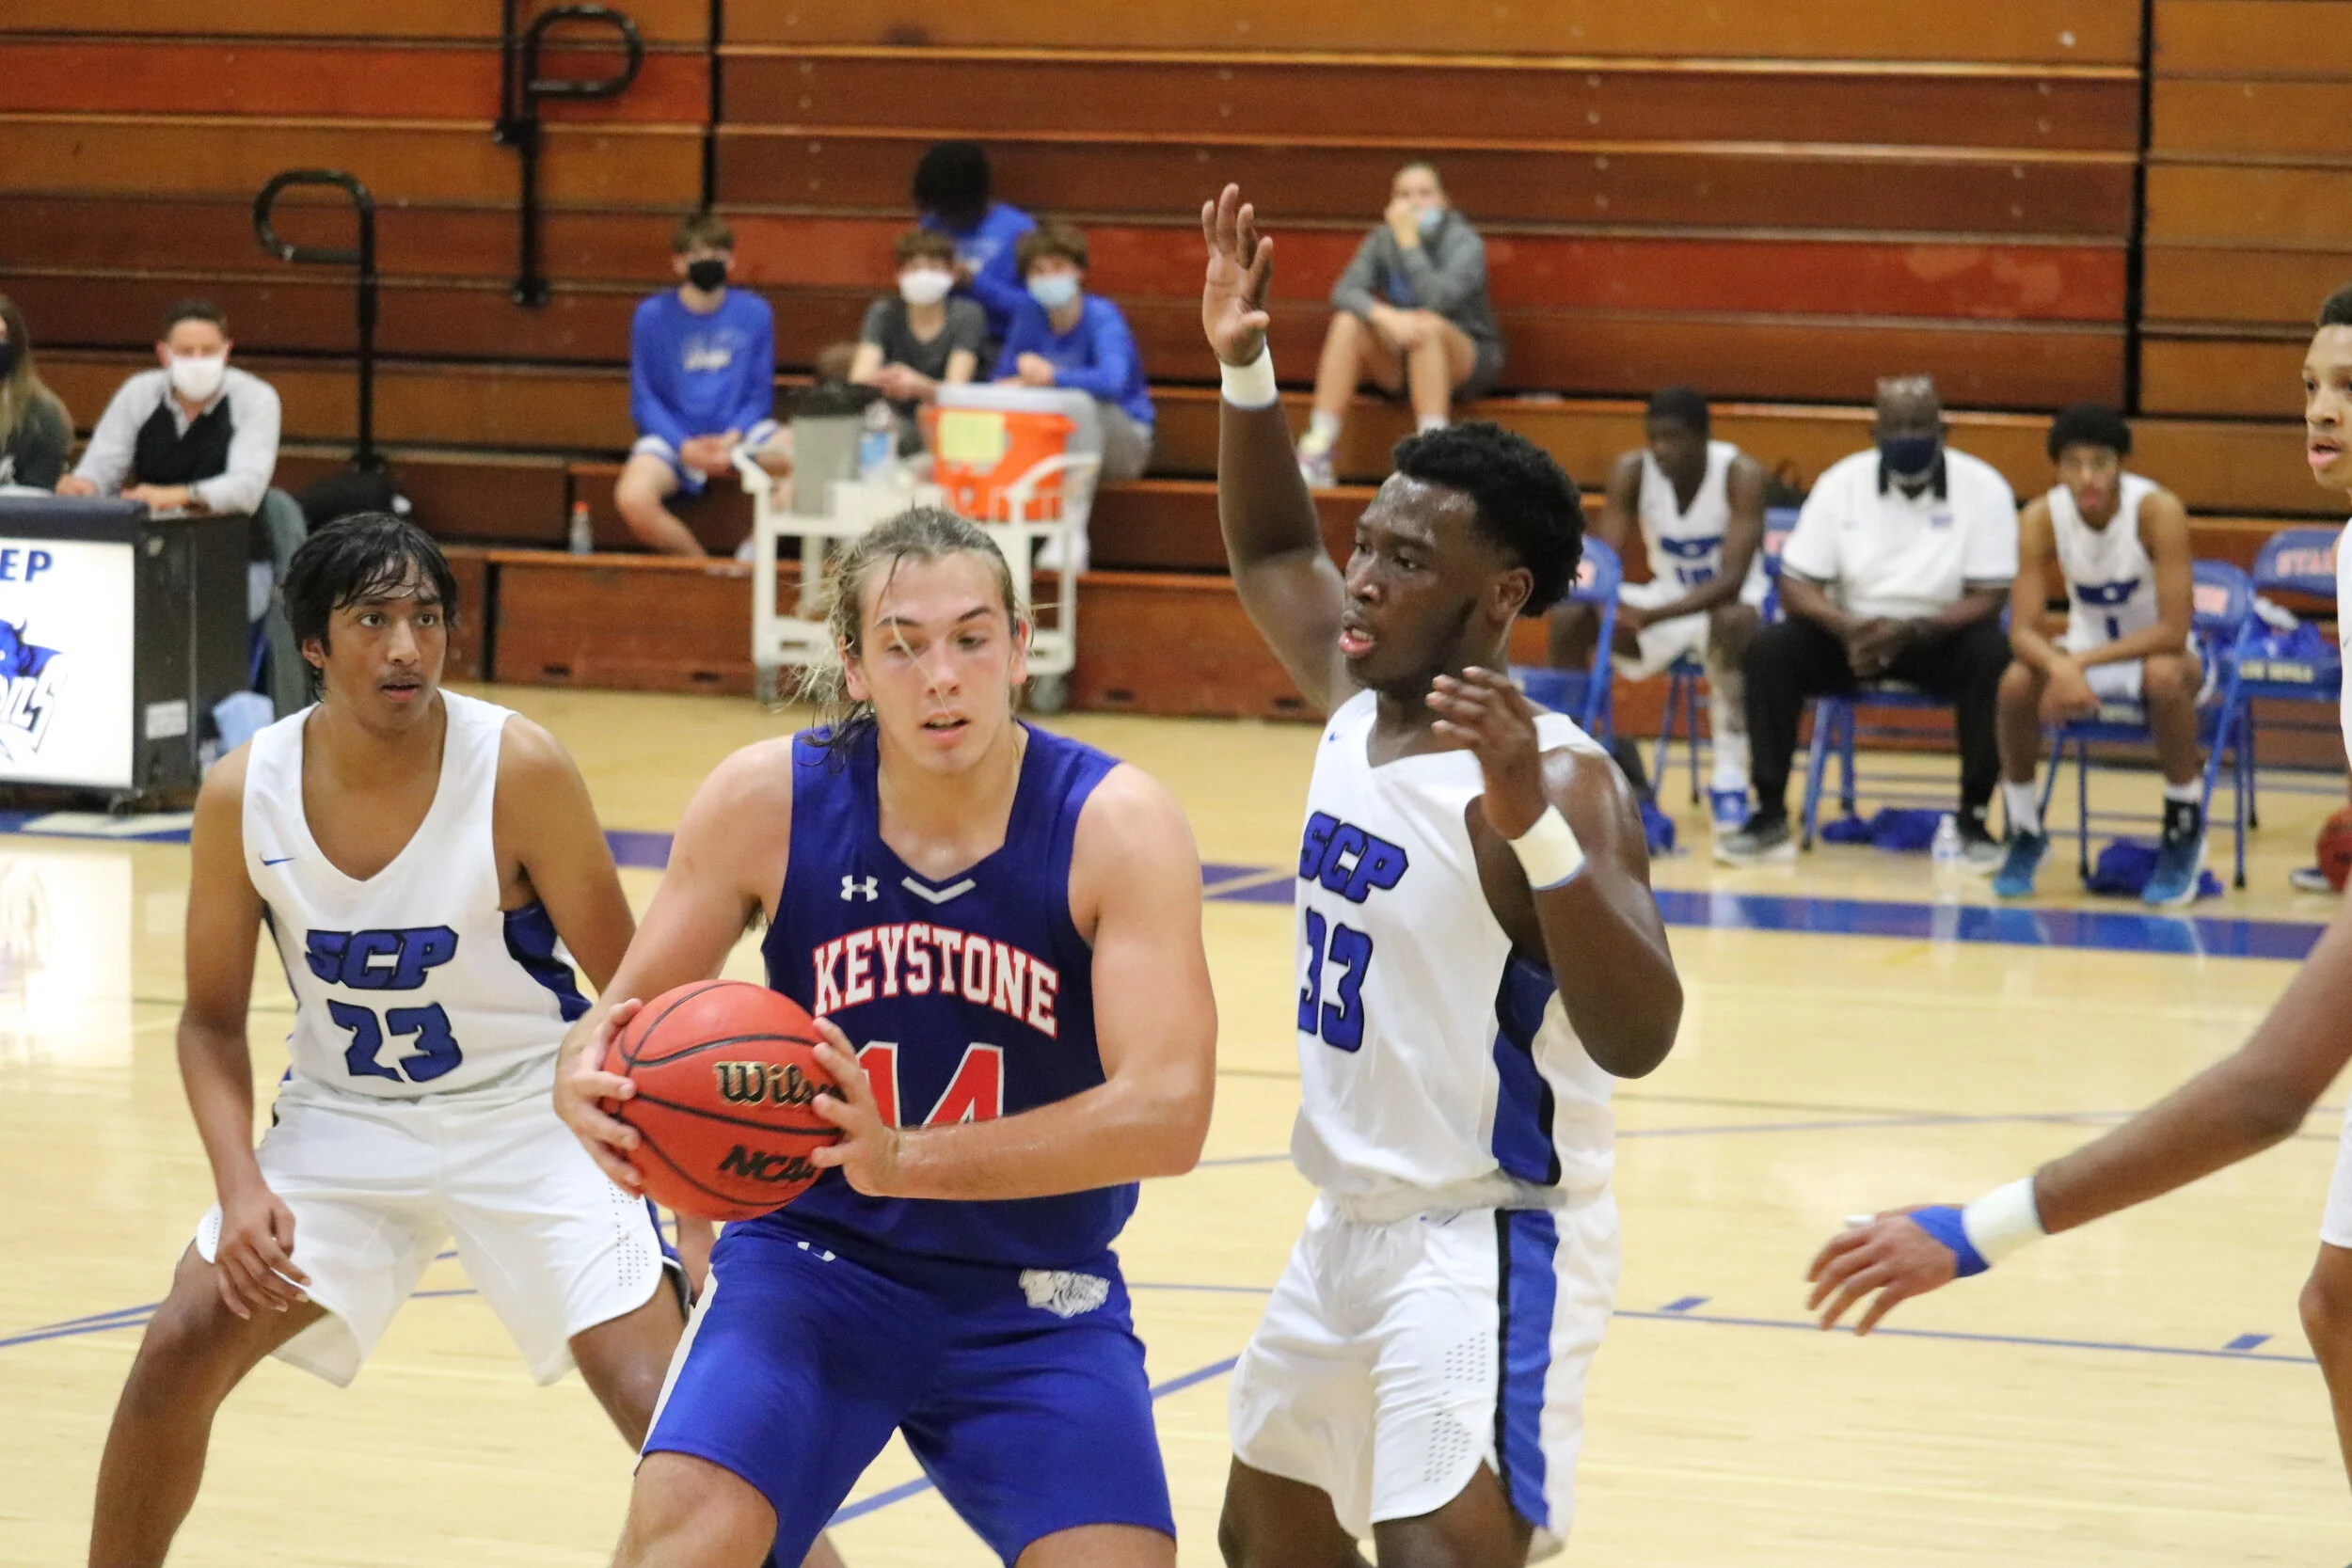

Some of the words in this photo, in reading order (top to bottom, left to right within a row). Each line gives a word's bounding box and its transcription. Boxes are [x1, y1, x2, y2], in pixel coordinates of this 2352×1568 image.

[1299, 811, 1409, 904] SCP
[305, 925, 459, 990] SCP
[812, 921, 1059, 1040] KEYSTONE
[326, 998, 463, 1083] 23
[854, 1040, 1004, 1130] 14
